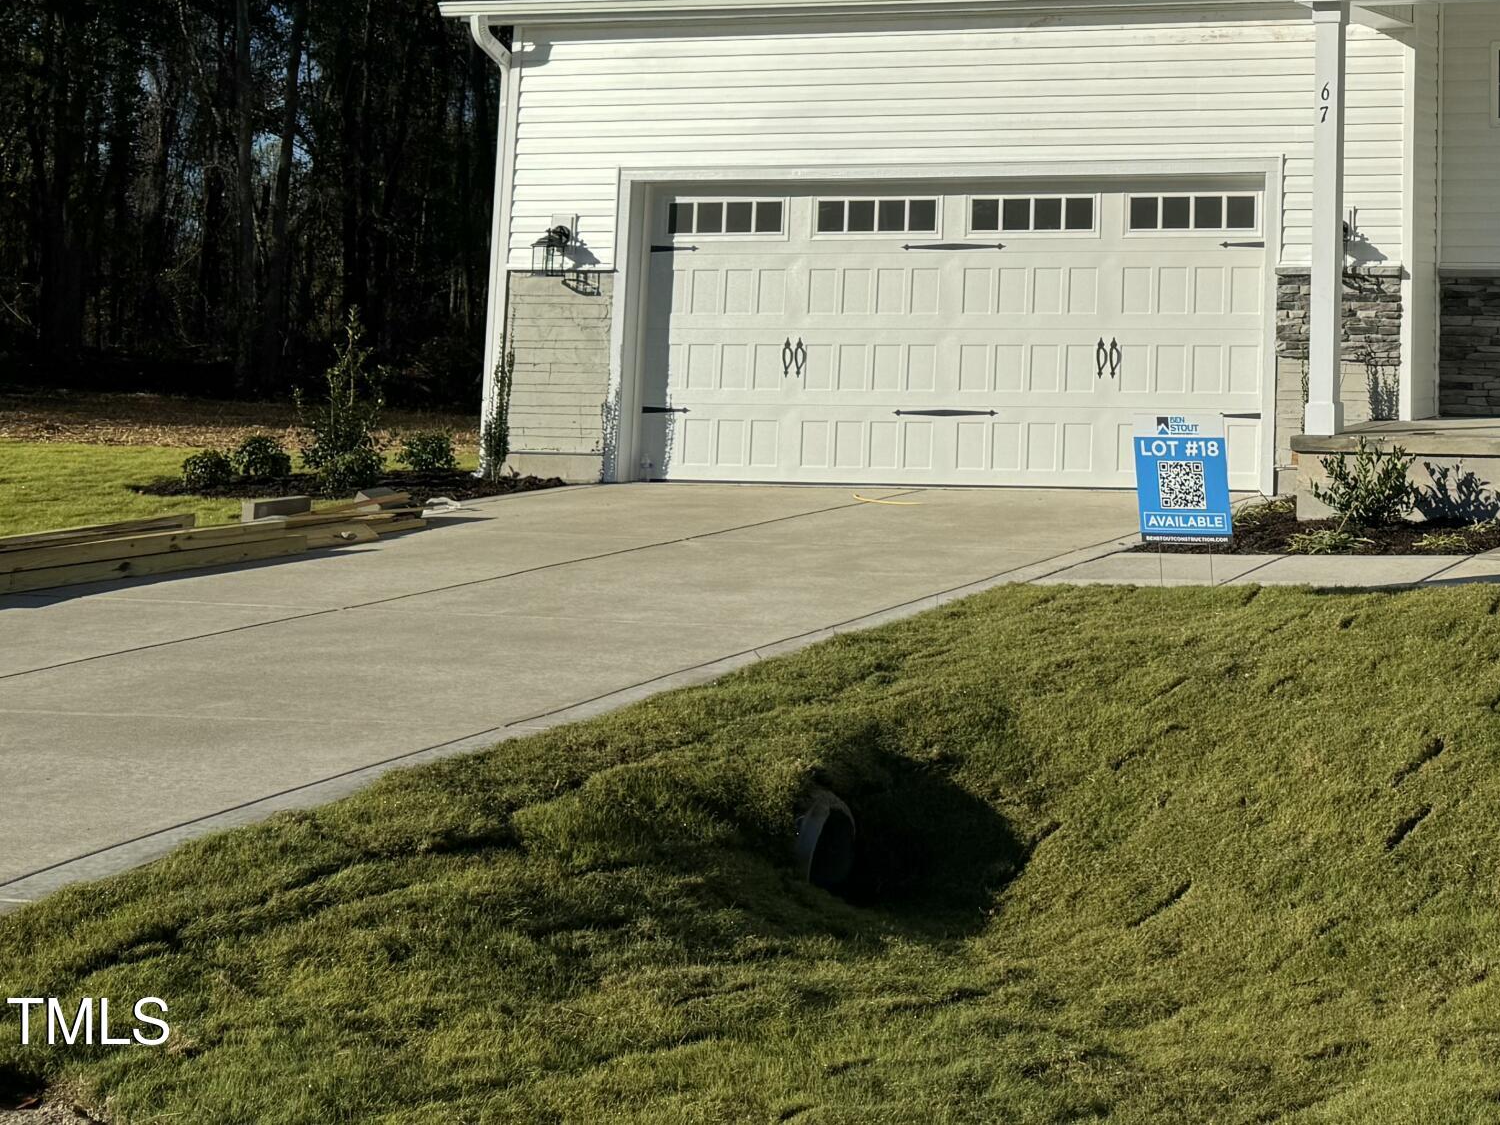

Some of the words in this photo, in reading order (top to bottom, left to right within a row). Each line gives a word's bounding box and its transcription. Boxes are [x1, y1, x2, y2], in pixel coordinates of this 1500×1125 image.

[1170, 416, 1185, 424] BEN
[1170, 424, 1199, 432] STOUT
[1140, 440, 1179, 457] LOT
[1185, 440, 1220, 457] #18
[1148, 515, 1224, 528] AVAILABLE
